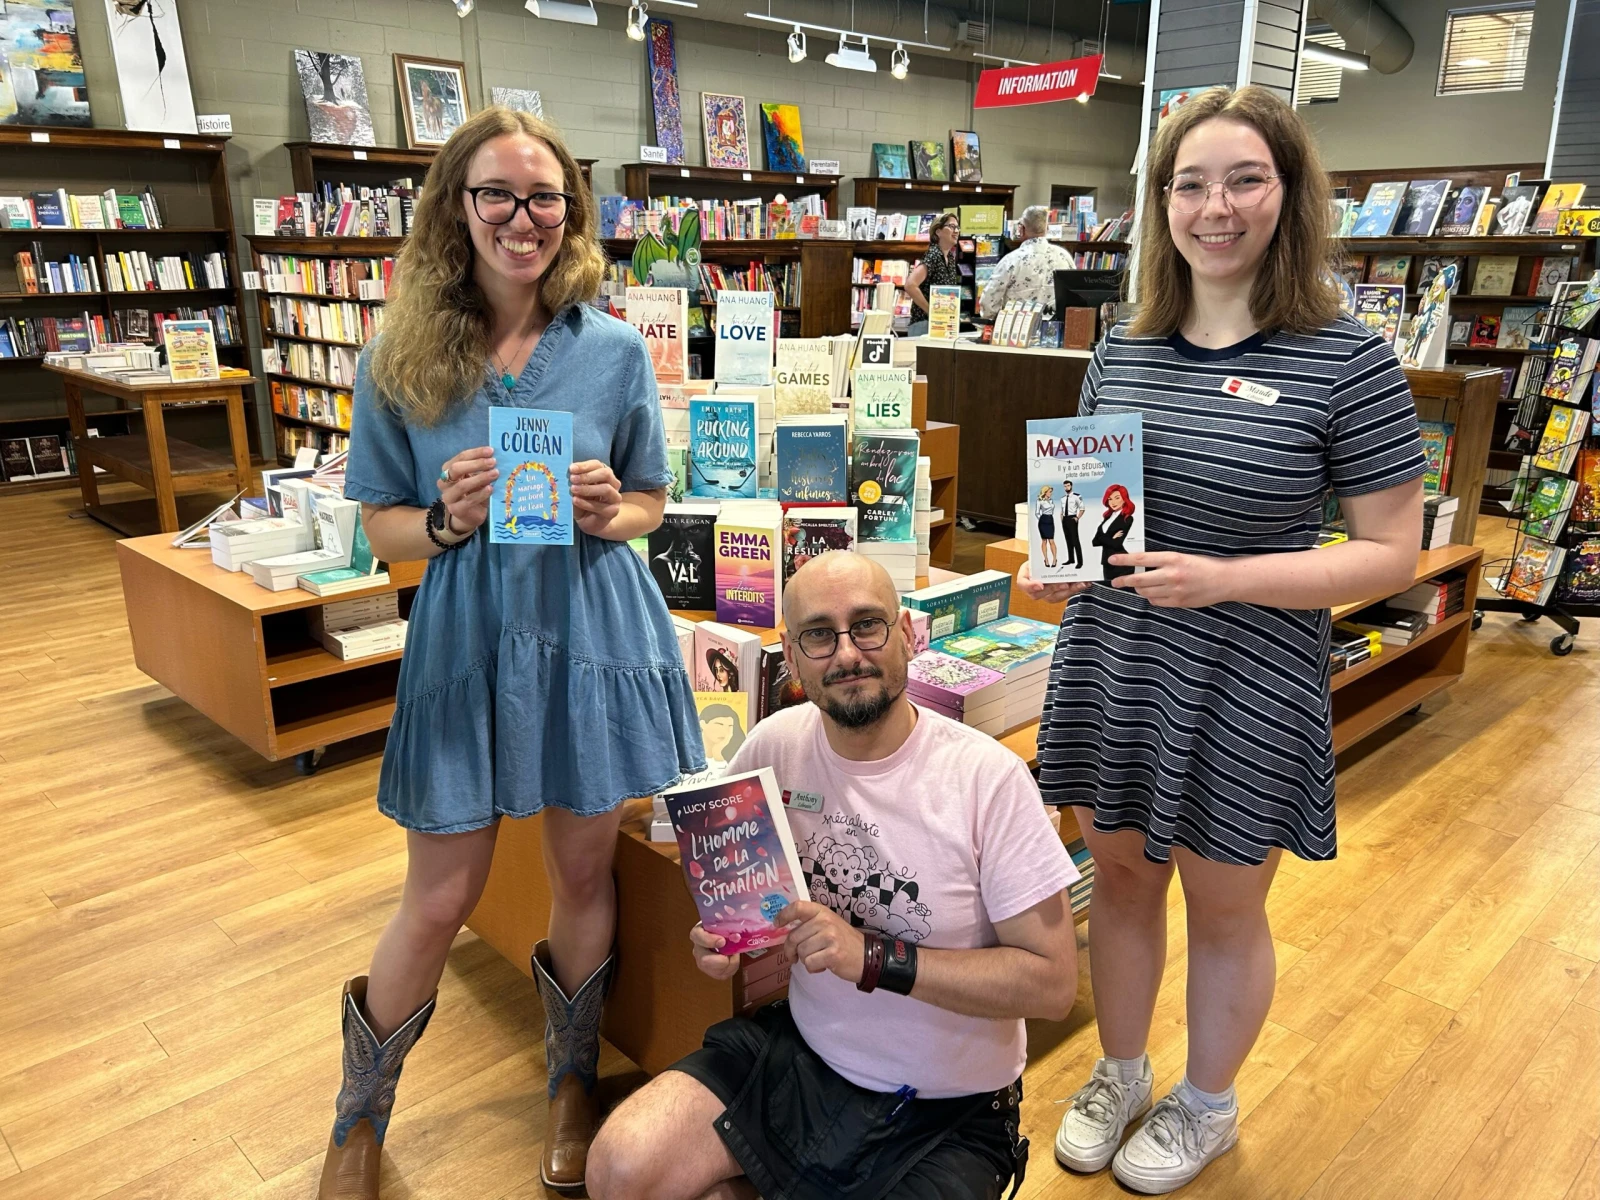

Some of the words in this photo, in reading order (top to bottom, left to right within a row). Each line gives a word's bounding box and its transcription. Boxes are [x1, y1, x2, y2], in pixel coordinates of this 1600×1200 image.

[997, 68, 1078, 95] INFORMATION
[197, 118, 230, 130] Histoire
[643, 148, 664, 159] Santé
[627, 293, 644, 301] ANA
[646, 293, 676, 302] HUANG
[719, 296, 736, 304] ANA
[738, 296, 768, 305] HUANG
[720, 324, 766, 341] LOVE
[778, 343, 796, 352] ANA
[797, 343, 827, 352] HUANG
[777, 372, 830, 386] GAMES
[857, 373, 875, 382] ANA
[877, 373, 907, 382] HUANG
[1245, 385, 1273, 398] Maude
[701, 405, 722, 413] EMILY
[867, 403, 901, 418] LIES
[515, 416, 550, 433] JENNY
[696, 419, 751, 441] PUCKING
[1071, 424, 1089, 433] Sylvie
[501, 432, 563, 456] COLGAN
[697, 441, 749, 461] AROUND
[857, 440, 915, 464] Rendez-vous
[868, 456, 884, 468] bord
[1081, 461, 1114, 471] SÉDUISANT
[526, 474, 537, 482] Un
[884, 459, 908, 488] lac
[518, 483, 544, 493] mariage
[795, 486, 831, 501] infinies
[517, 494, 527, 502] au
[528, 491, 544, 501] bord
[517, 503, 527, 512] de
[528, 502, 544, 510] l'eau
[867, 509, 896, 517] CARLEY
[863, 514, 898, 523] FORTUNE
[720, 531, 770, 548] EMMA
[812, 536, 826, 545] LA
[719, 545, 771, 561] GREEN
[667, 561, 699, 583] VAL
[972, 584, 993, 594] SORAYA
[725, 588, 765, 604] INTERDITS
[926, 599, 948, 608] SORAYA
[683, 802, 707, 815] LUCY
[709, 794, 744, 809] SCORE
[794, 793, 818, 806] Anthony
[822, 811, 880, 838] spécialiste
[846, 828, 858, 837] en
